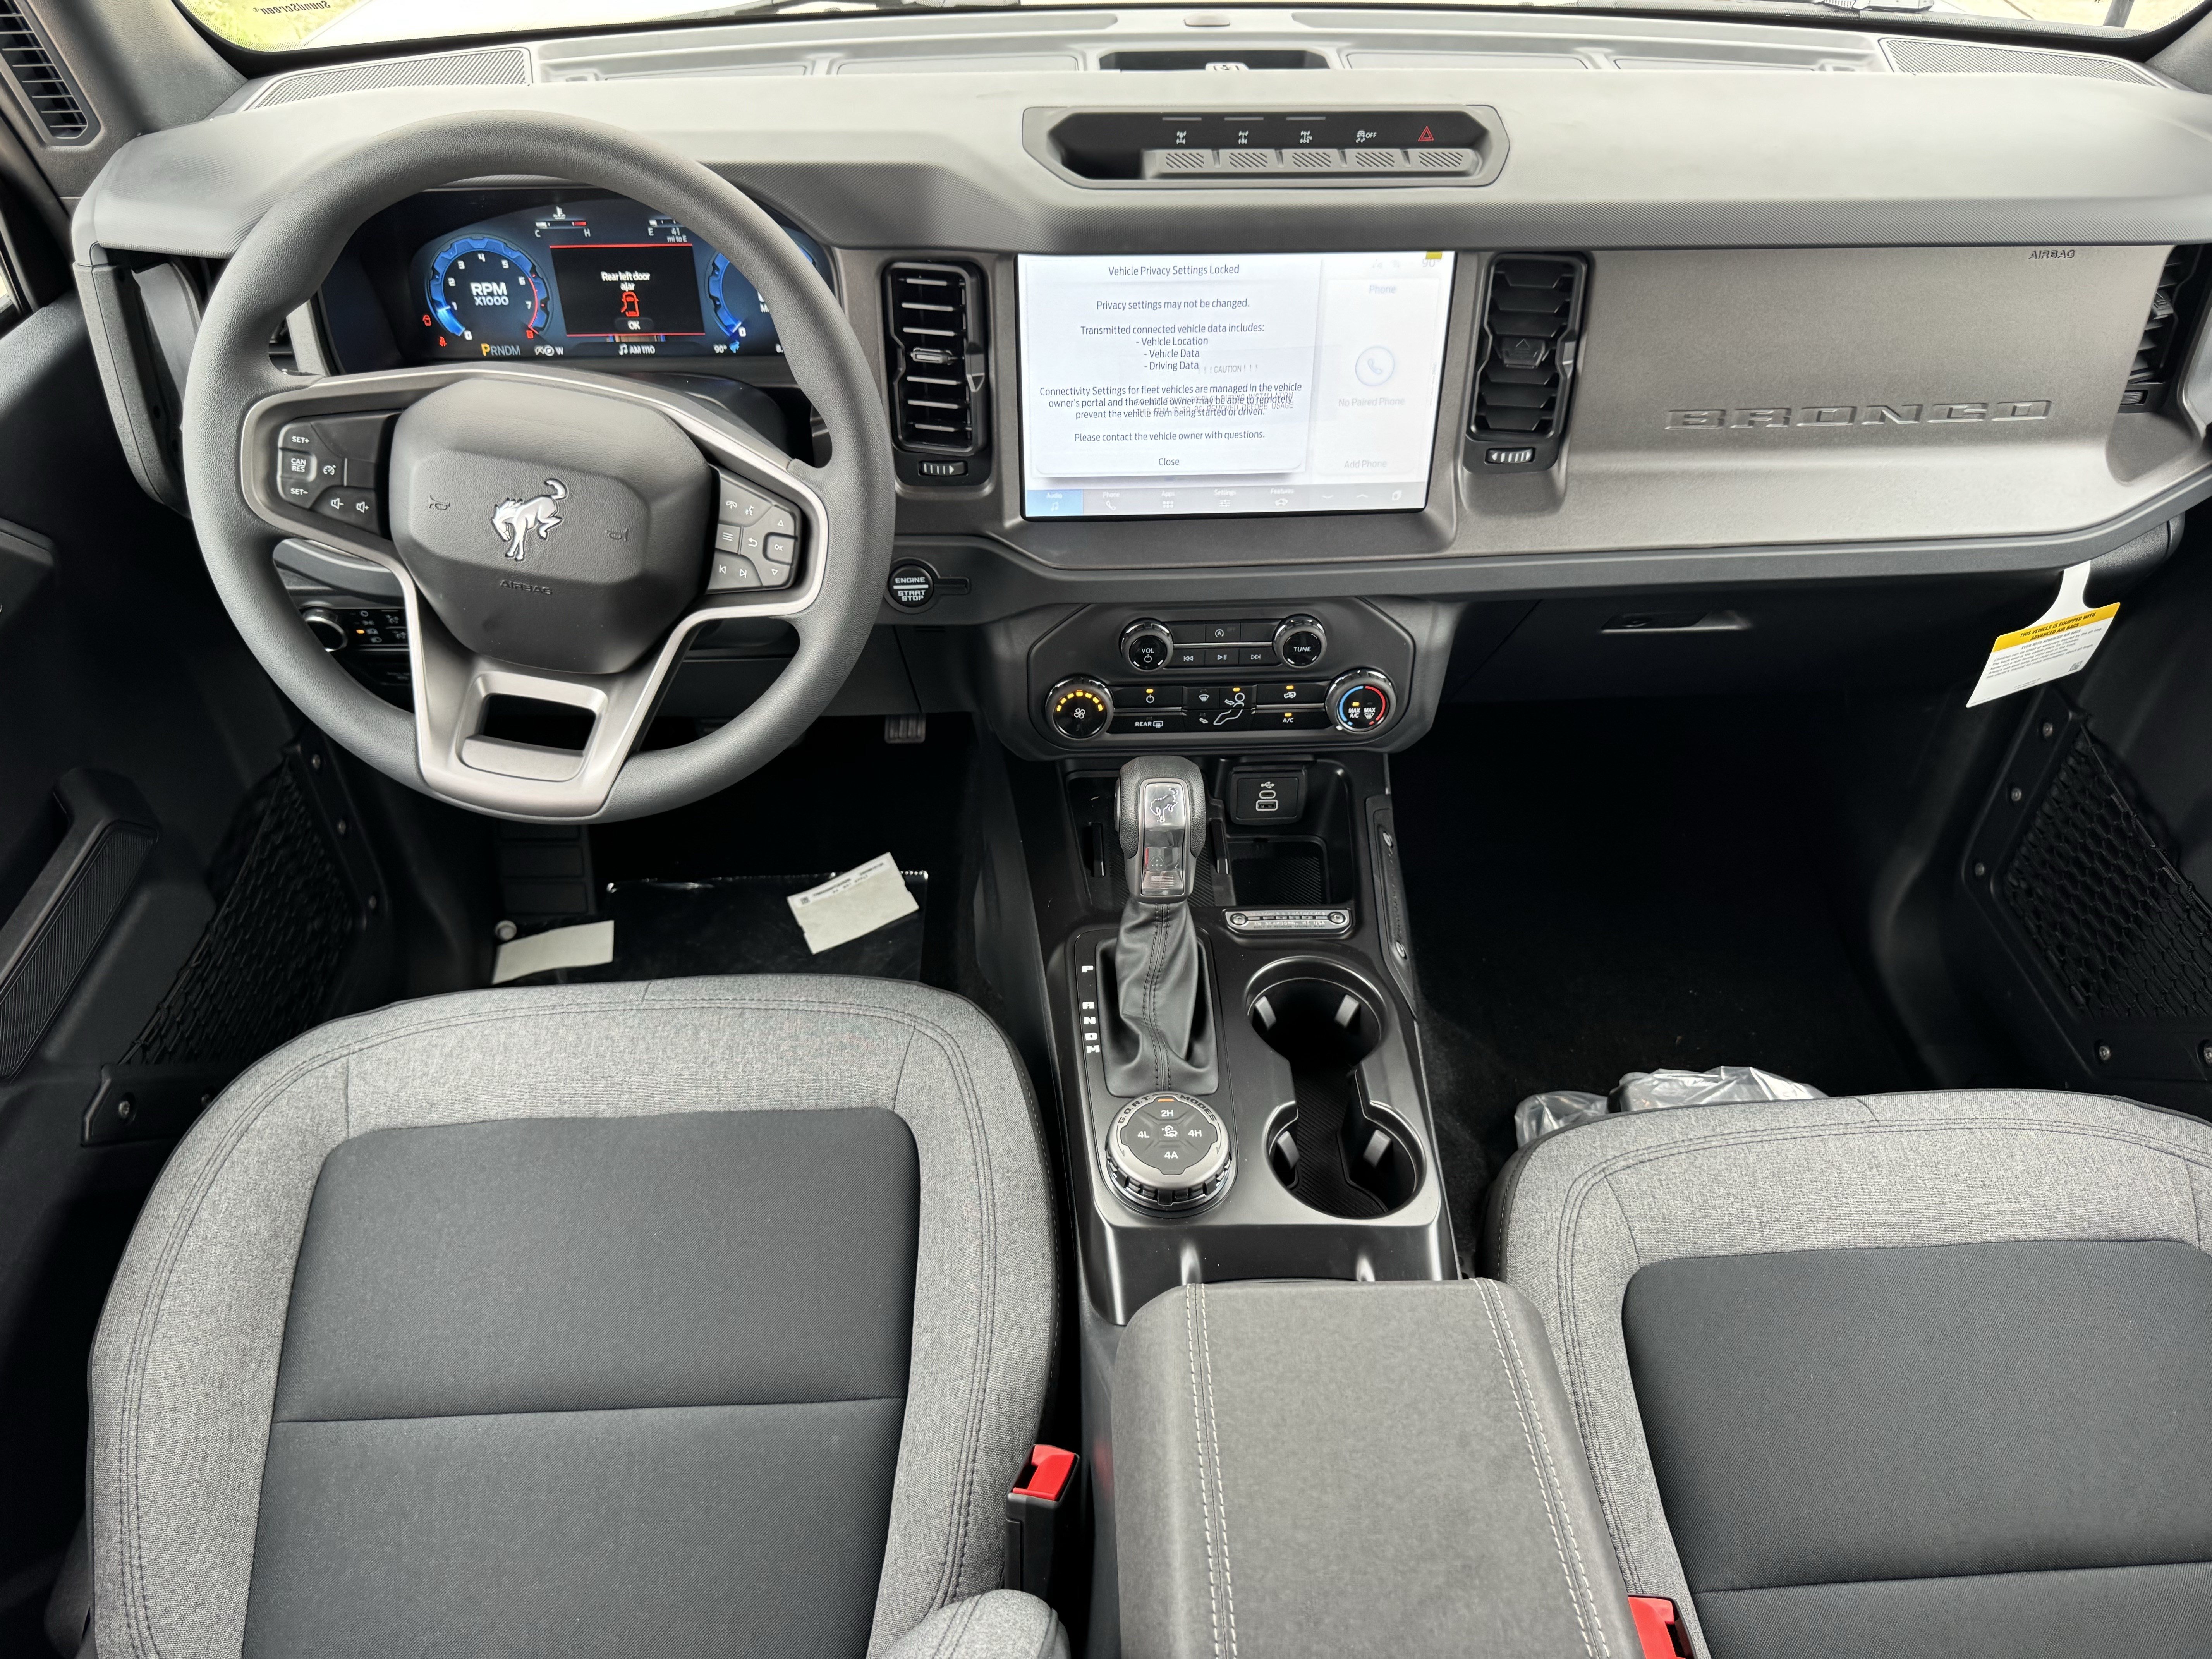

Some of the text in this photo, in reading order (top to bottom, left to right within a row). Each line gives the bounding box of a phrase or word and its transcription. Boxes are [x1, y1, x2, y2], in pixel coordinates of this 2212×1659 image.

[534, 230, 541, 238] C
[584, 228, 591, 237] H
[648, 228, 654, 236] E
[478, 253, 485, 262] 4
[2028, 249, 2075, 259] AIRBAG
[458, 261, 465, 269] 3
[502, 260, 509, 268] 5
[1109, 264, 1240, 276] Vehicle Privacy Settings Locked
[518, 276, 526, 285] 6
[601, 271, 650, 281] Rear left door
[448, 277, 455, 286] 2
[470, 282, 508, 295] RPM
[620, 282, 635, 292] ajar
[1369, 285, 1396, 294] Phone
[452, 301, 457, 310] 1
[473, 296, 509, 306] X1000
[526, 301, 532, 309] 7
[1097, 301, 1126, 311] Privacy
[1128, 300, 1161, 311] settings
[1164, 301, 1182, 309] may
[1200, 299, 1210, 308] be
[1212, 298, 1250, 309] changed.
[627, 320, 641, 330] OK
[1081, 323, 1264, 335] Transmitted connected vehicle data includes:
[464, 330, 472, 340] 0
[738, 327, 746, 337] 0
[1142, 337, 1170, 346] Vehicle
[1173, 337, 1208, 345] Location
[555, 347, 564, 356] W
[630, 345, 641, 354] AM
[1149, 349, 1178, 358] Vehicle
[1180, 349, 1200, 357] Data
[1150, 361, 1177, 371] Driving
[1180, 361, 1199, 369] Data
[1040, 387, 1090, 397] Connectivity
[1092, 386, 1126, 396] Settings
[1128, 386, 1139, 394] for
[1141, 386, 1159, 394] fleet
[1162, 385, 1193, 394] vehicles
[1210, 384, 1248, 394] managed
[1250, 384, 1257, 392] in
[1259, 383, 1272, 392] the
[1274, 383, 1302, 391] vehicle
[1049, 399, 1080, 407] owner's
[1082, 398, 1105, 408] portal
[1108, 398, 1123, 406] and
[1125, 398, 1137, 406] the
[1140, 397, 1167, 405] vehicle
[1196, 397, 1213, 406] may
[1216, 395, 1225, 404] be
[1227, 395, 1244, 404] able
[1247, 396, 1254, 404] to
[1257, 395, 1292, 404] remotely
[1076, 410, 1106, 420] prevent
[1124, 409, 1151, 418] vehicle
[1154, 408, 1172, 417] from
[1174, 407, 1195, 418] being
[1198, 407, 1226, 416] started
[1238, 407, 1265, 416] driven.
[1664, 400, 2052, 430] BRONCO
[1075, 433, 1100, 441] Please
[1102, 433, 1132, 441] contact
[1149, 432, 1176, 440] vehicle
[1224, 431, 1265, 440] questions.
[1159, 458, 1179, 466] Close
[1345, 460, 1387, 469] Add Phone
[500, 580, 552, 594] AIRBAG
[2032, 625, 2052, 634] VEHICLE
[2058, 616, 2082, 627] EQUIPPED
[2029, 630, 2056, 641] ADVANCED
[1086, 1045, 1100, 1053] M
[1180, 1095, 1217, 1121] MODES
